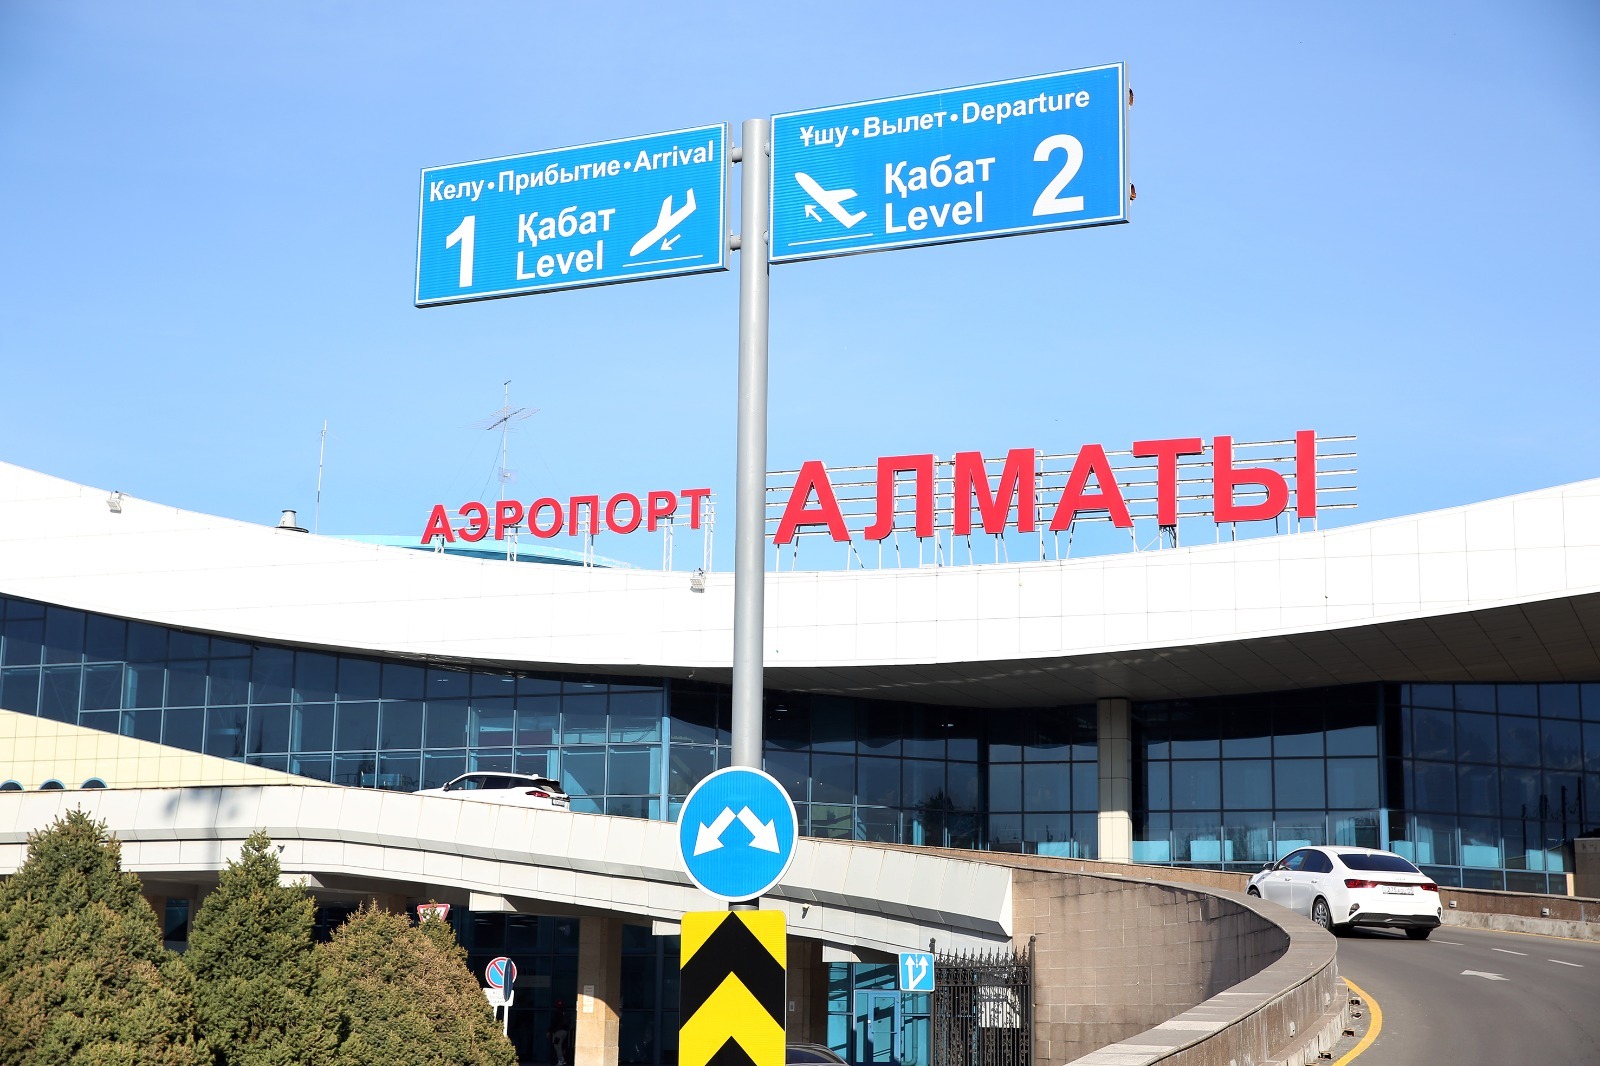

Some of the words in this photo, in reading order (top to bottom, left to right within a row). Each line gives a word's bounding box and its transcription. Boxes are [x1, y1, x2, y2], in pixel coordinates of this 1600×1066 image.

[863, 111, 947, 139] Вылет
[962, 90, 1090, 125] Departure
[498, 159, 621, 196] Прибытие
[633, 139, 714, 173] Arrival
[885, 154, 996, 199] Қабат
[1032, 133, 1085, 217] 2
[517, 205, 616, 248] Қабат
[885, 190, 983, 234] Level
[445, 215, 476, 288] 1
[516, 239, 604, 281] Level
[421, 487, 711, 544] АЭРОПОРТ
[773, 429, 1317, 545] АЛМАТЫ
